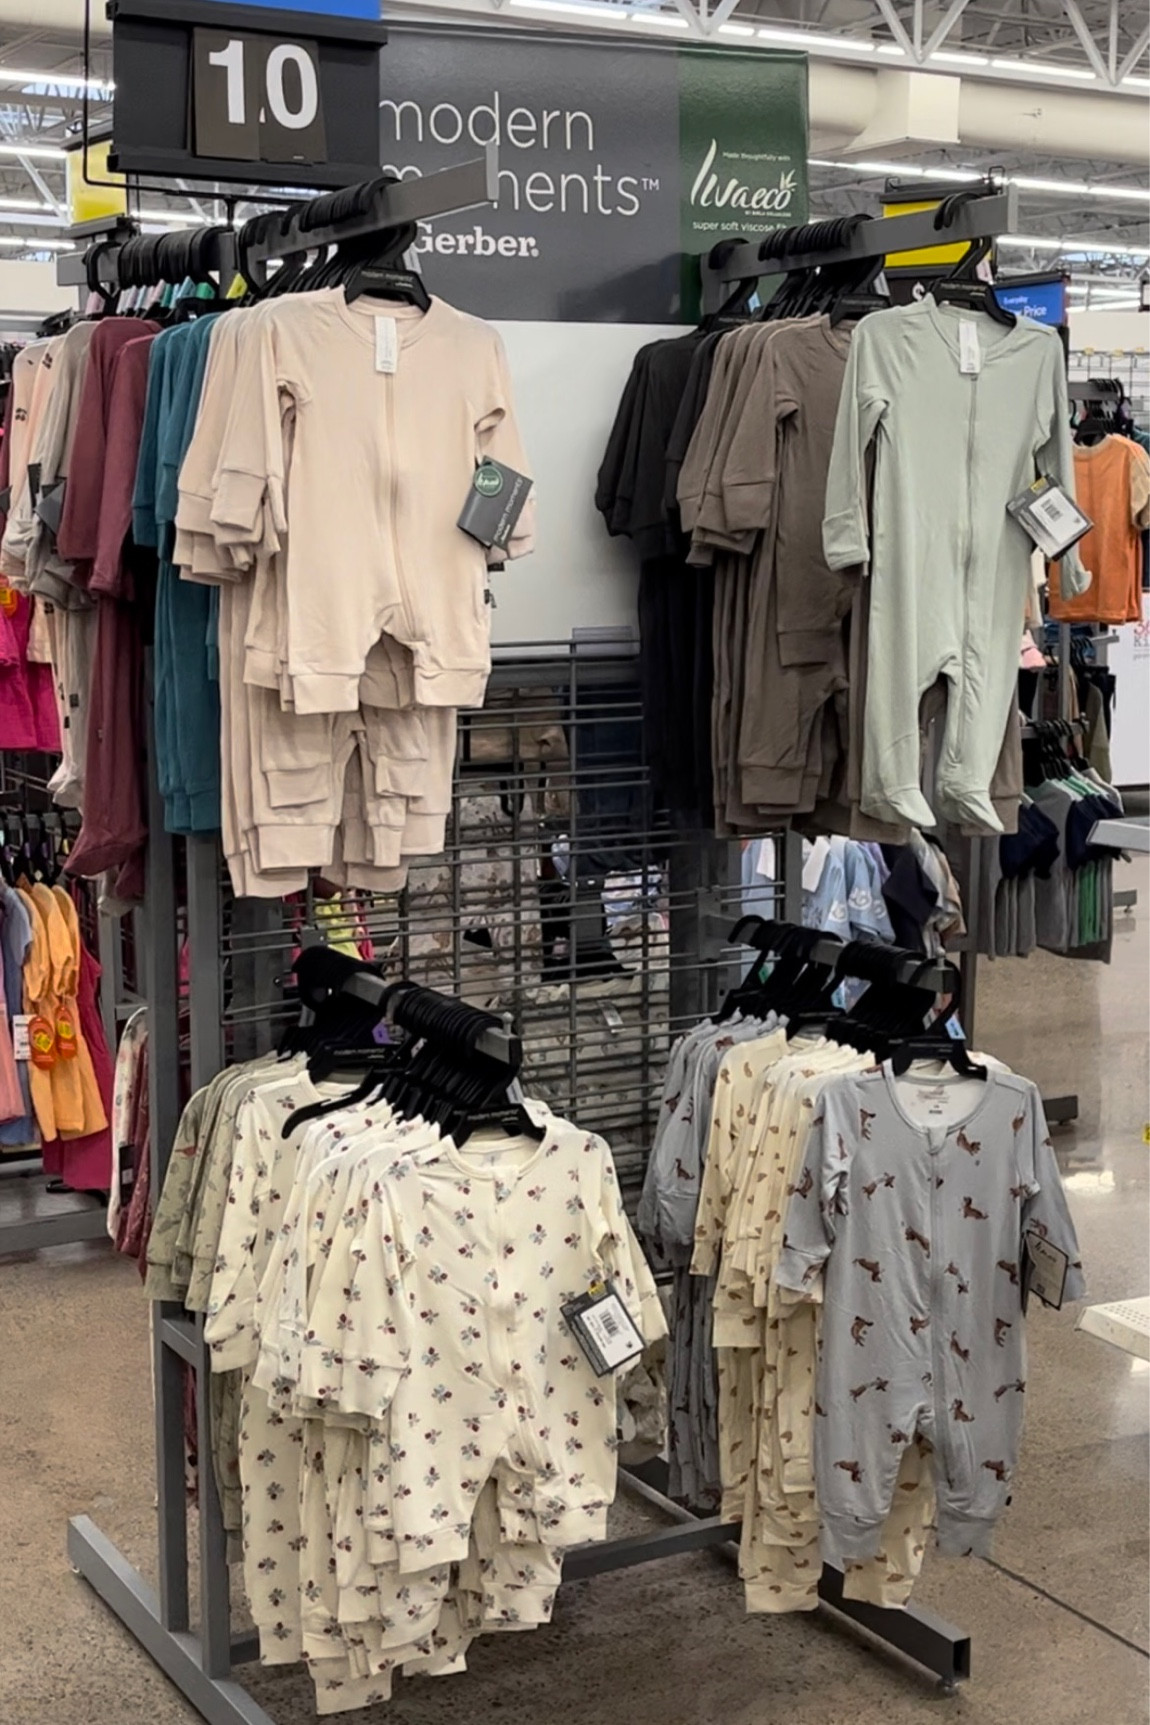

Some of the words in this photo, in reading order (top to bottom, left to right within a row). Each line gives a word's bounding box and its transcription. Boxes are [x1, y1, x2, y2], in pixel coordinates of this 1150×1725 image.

[379, 90, 594, 152] modern
[692, 221, 719, 231] super
[720, 221, 739, 231] soft
[1023, 304, 1048, 318] Price
